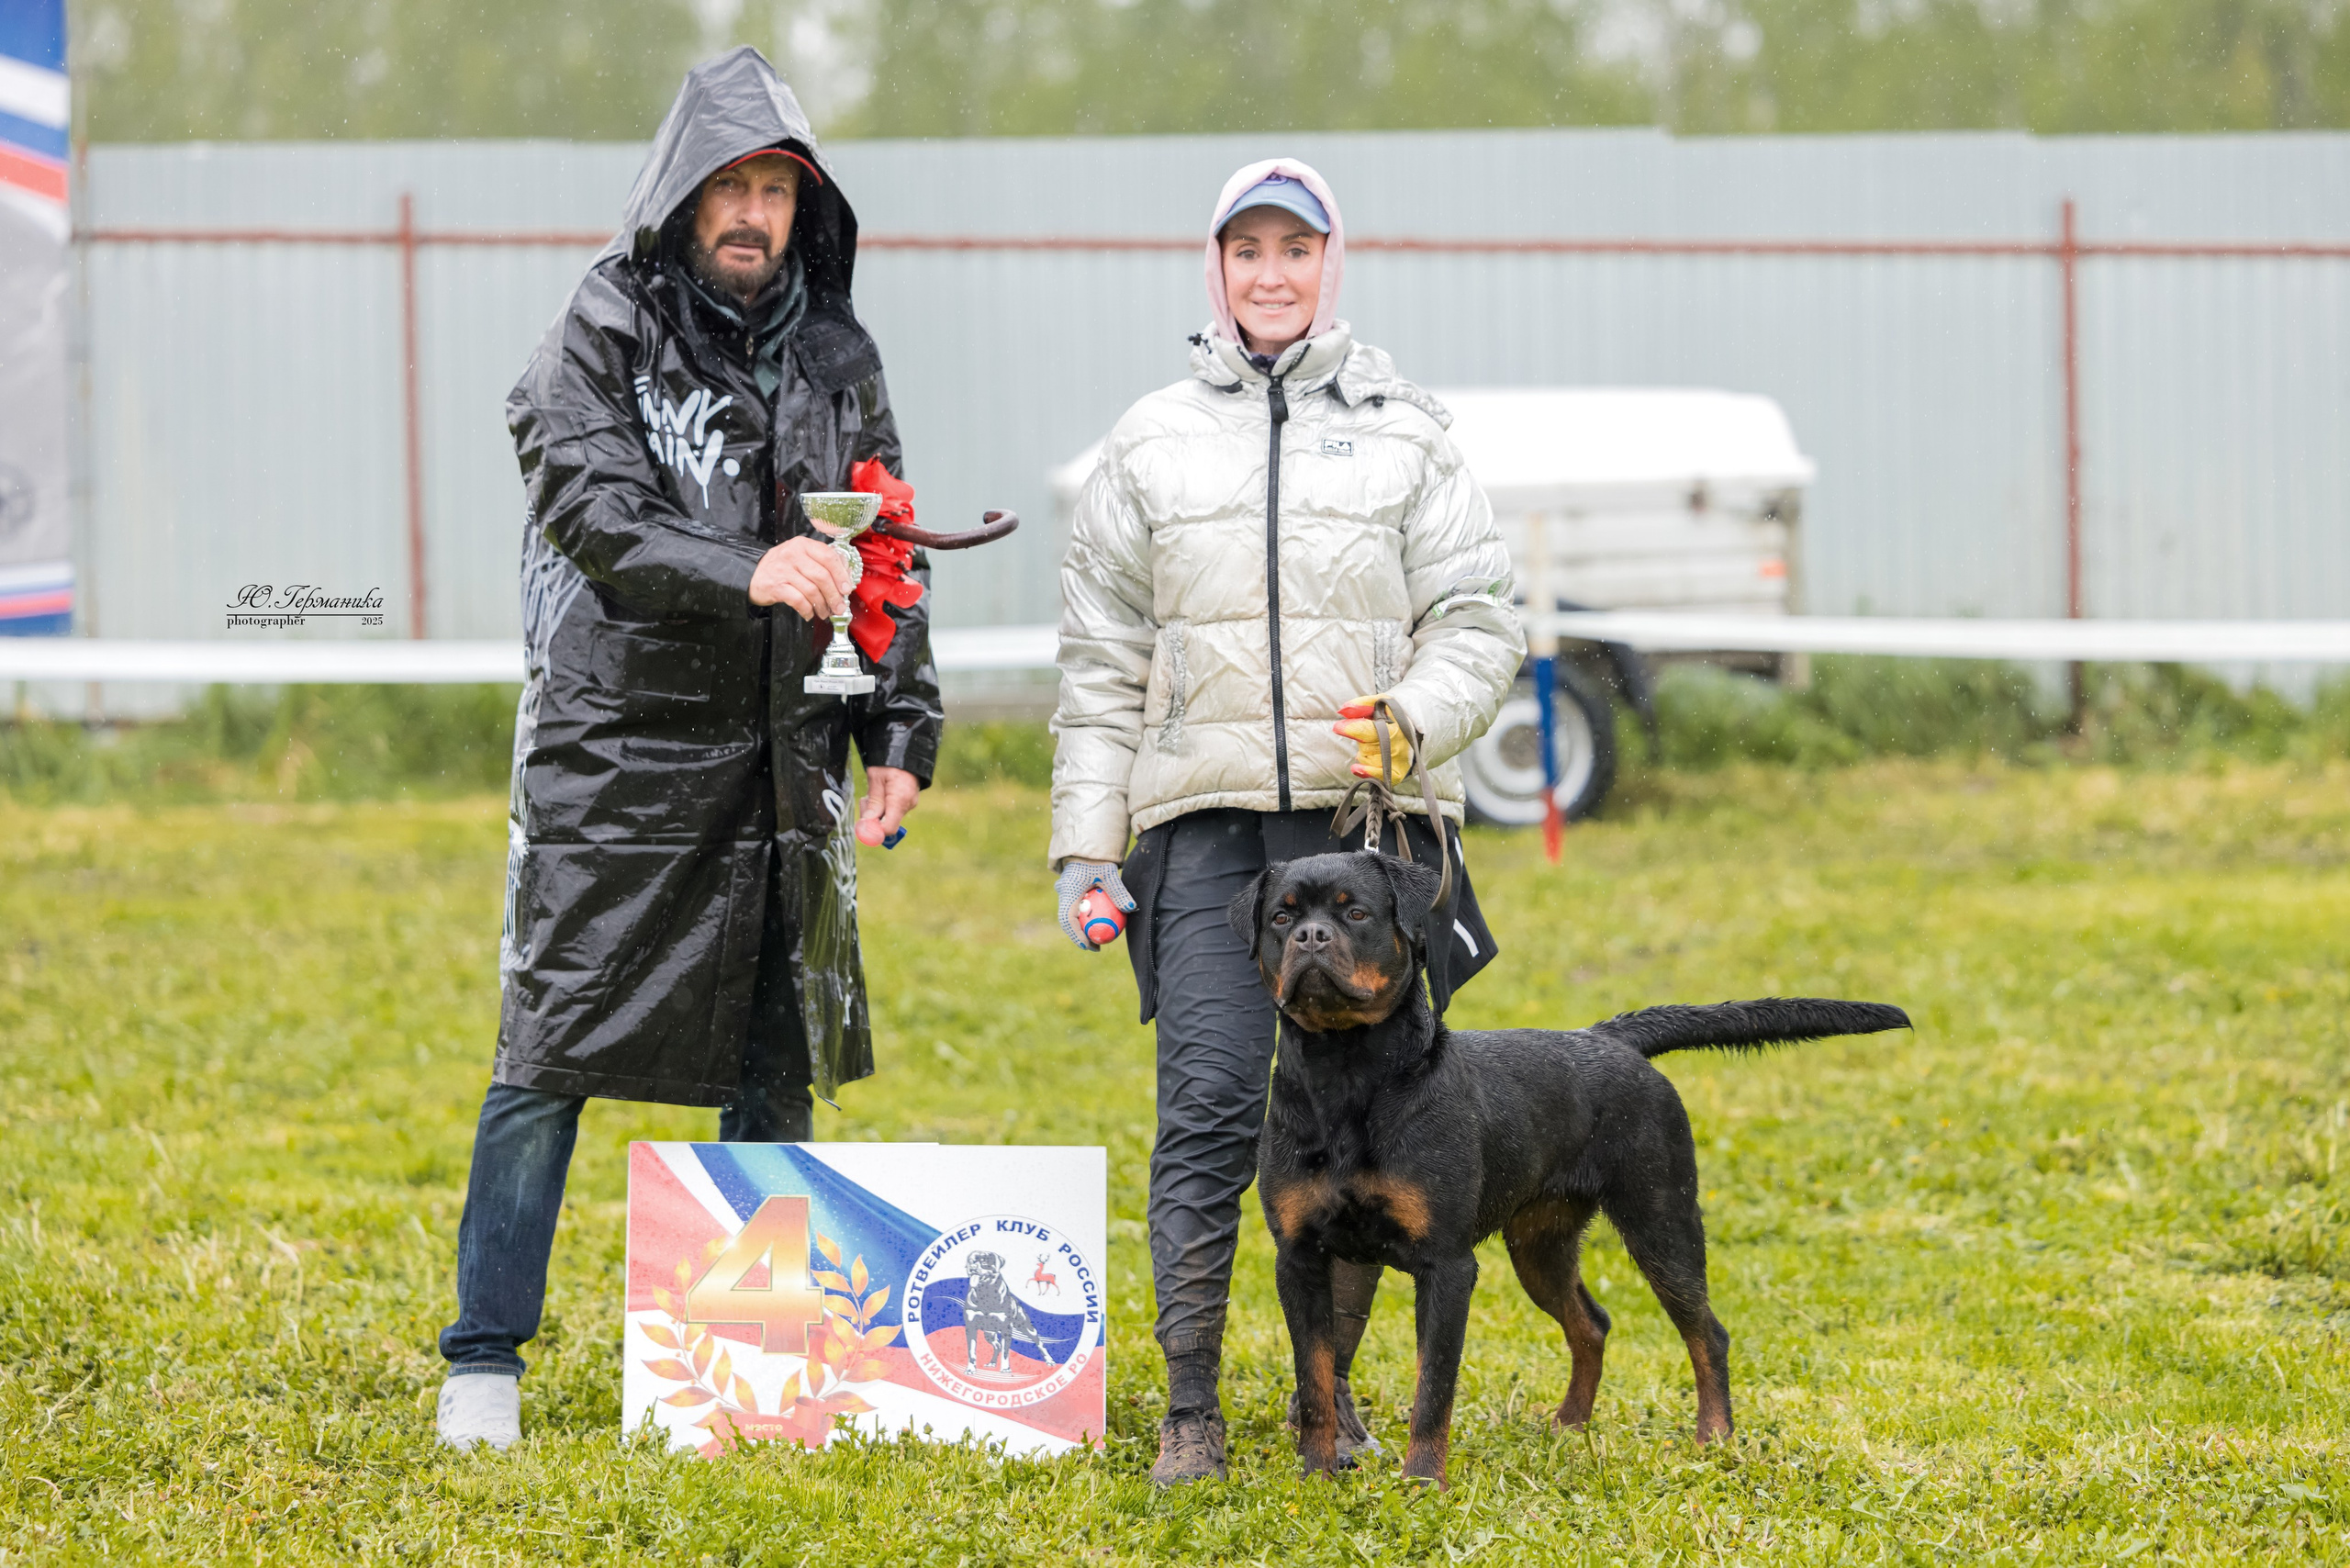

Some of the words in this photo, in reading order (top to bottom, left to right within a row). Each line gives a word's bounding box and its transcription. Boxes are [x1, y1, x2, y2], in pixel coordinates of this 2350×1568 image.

[686, 1194, 825, 1356] 4
[908, 1223, 982, 1324] РОТВЕЙЛЕР
[996, 1219, 1050, 1242] КЛУБ
[1057, 1242, 1100, 1324] РОССИИ
[919, 1352, 1069, 1407] НИЖЕГОРОДСКОЕ
[1069, 1352, 1089, 1375] РО
